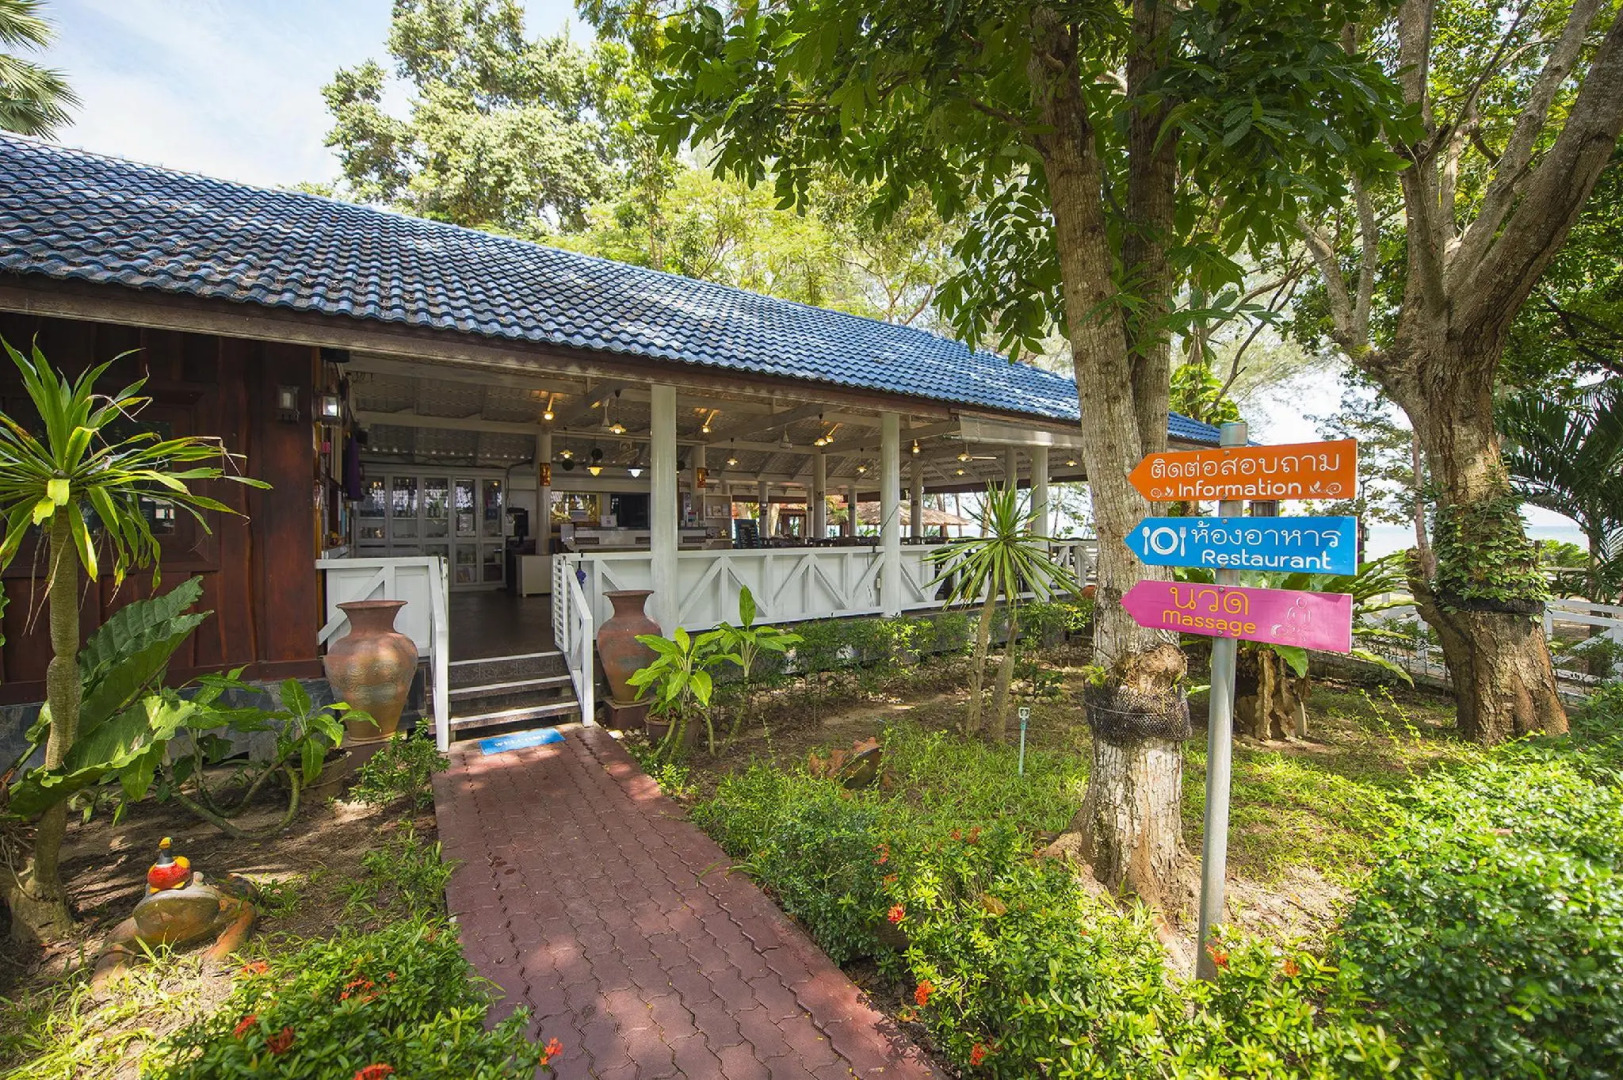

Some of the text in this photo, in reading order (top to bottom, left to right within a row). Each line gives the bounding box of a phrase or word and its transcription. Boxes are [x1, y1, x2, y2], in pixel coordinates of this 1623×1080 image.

[1150, 453, 1340, 479] ติดต่อสอบถาม
[1178, 478, 1302, 498] Information
[1190, 521, 1342, 548] ห้องอาหาร
[1201, 549, 1332, 570] Restaurant
[1169, 587, 1249, 616] นวด
